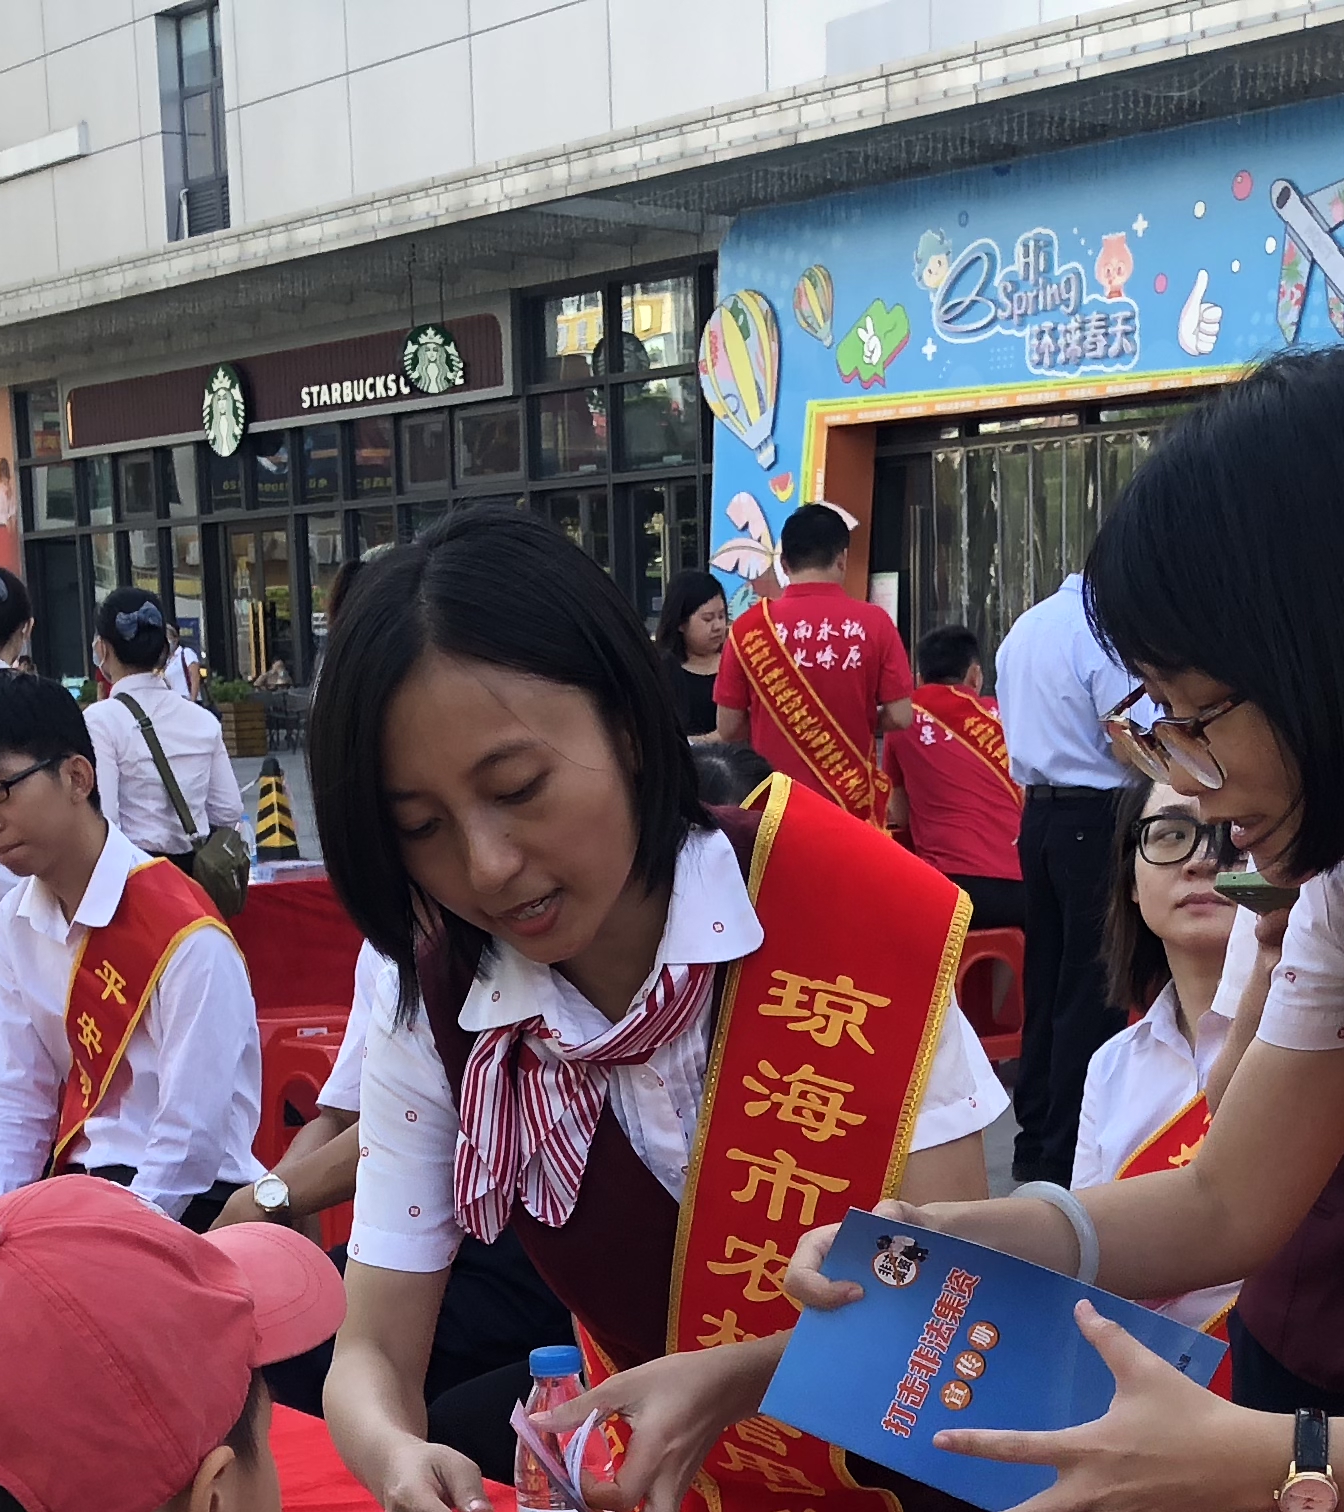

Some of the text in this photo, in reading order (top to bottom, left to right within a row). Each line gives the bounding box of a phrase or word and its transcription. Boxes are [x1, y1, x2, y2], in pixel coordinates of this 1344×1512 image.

[1019, 239, 1049, 284] Hi
[997, 272, 1082, 325] Spring
[300, 374, 397, 409] STARBUCKS
[880, 1266, 982, 1439] 打击非法集资
